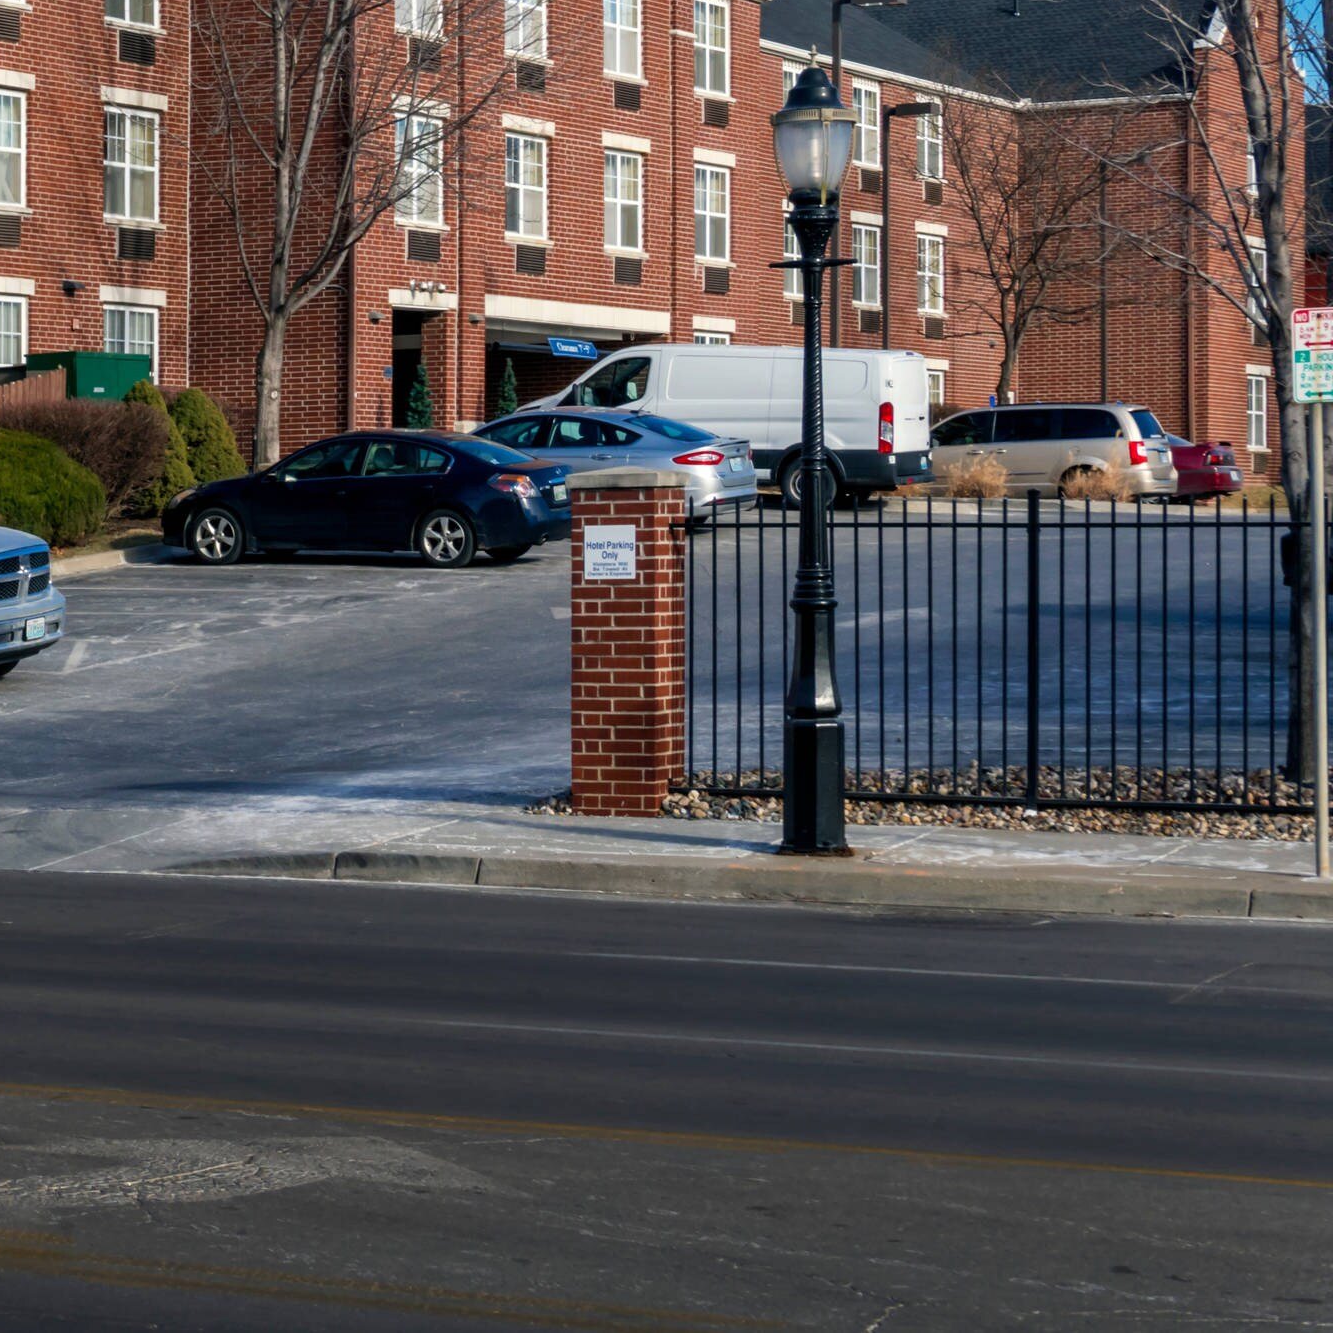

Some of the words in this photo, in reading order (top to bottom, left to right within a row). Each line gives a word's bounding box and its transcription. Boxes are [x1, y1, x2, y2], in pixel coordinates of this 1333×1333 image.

[586, 541, 605, 550] Hotel
[607, 541, 634, 551] Parking
[602, 551, 618, 561] Only
